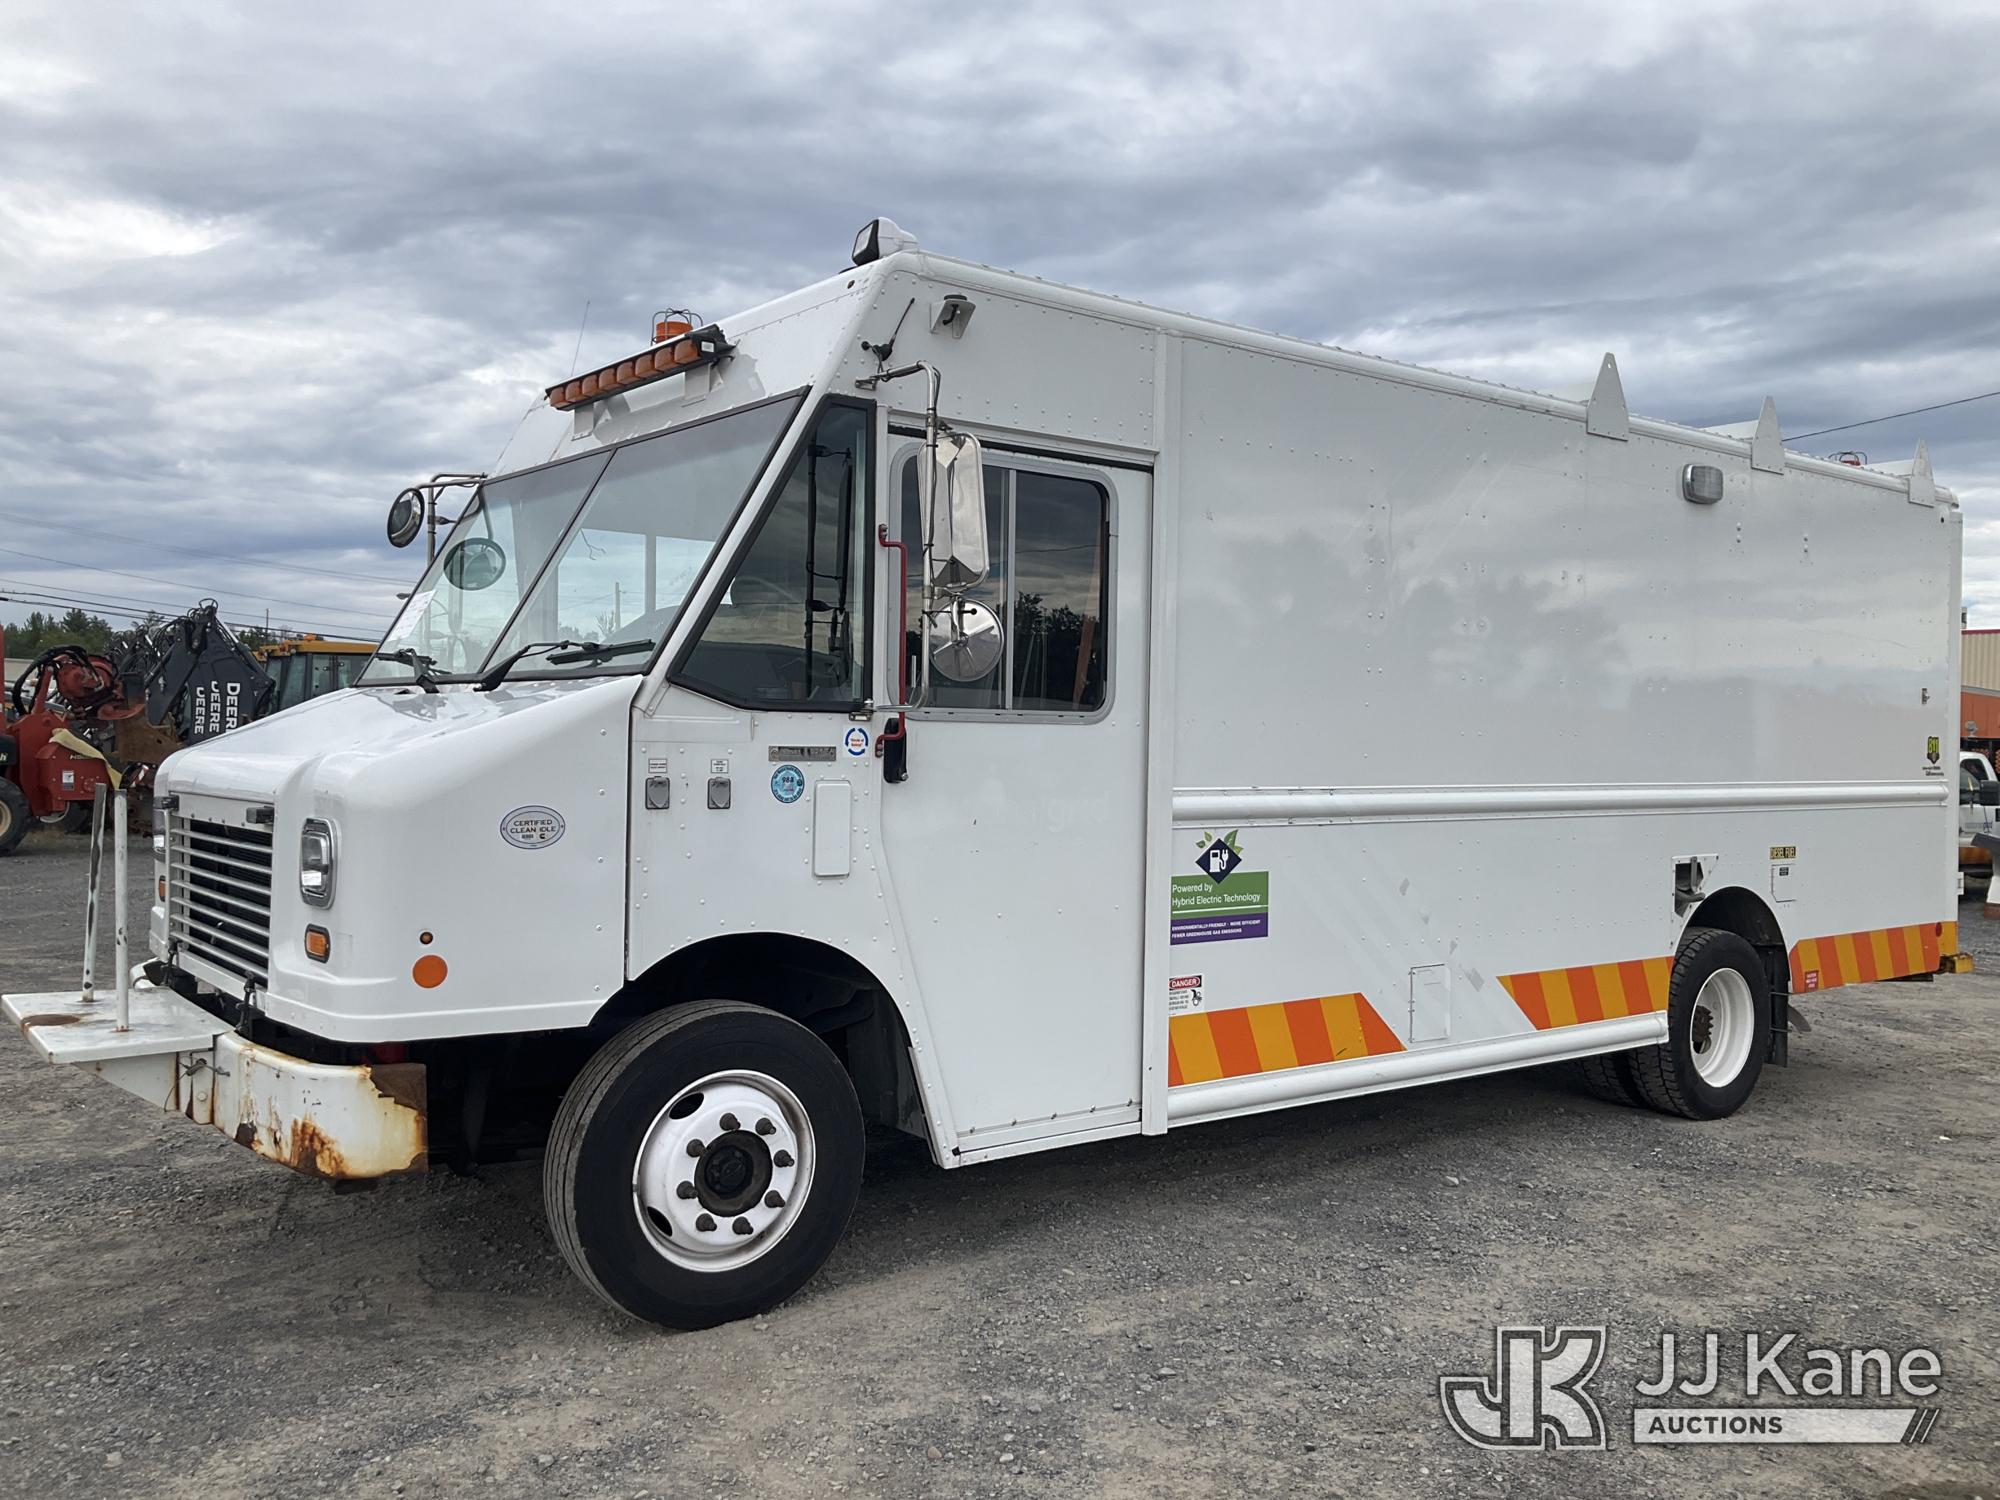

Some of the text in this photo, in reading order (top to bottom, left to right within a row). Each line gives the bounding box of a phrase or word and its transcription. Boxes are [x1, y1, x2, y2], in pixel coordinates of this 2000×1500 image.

[226, 682, 240, 733] DEER
[1172, 883, 1213, 894] Powered by
[1171, 892, 1261, 907] Hybrid Electric Technology
[1171, 979, 1197, 988] DANGER
